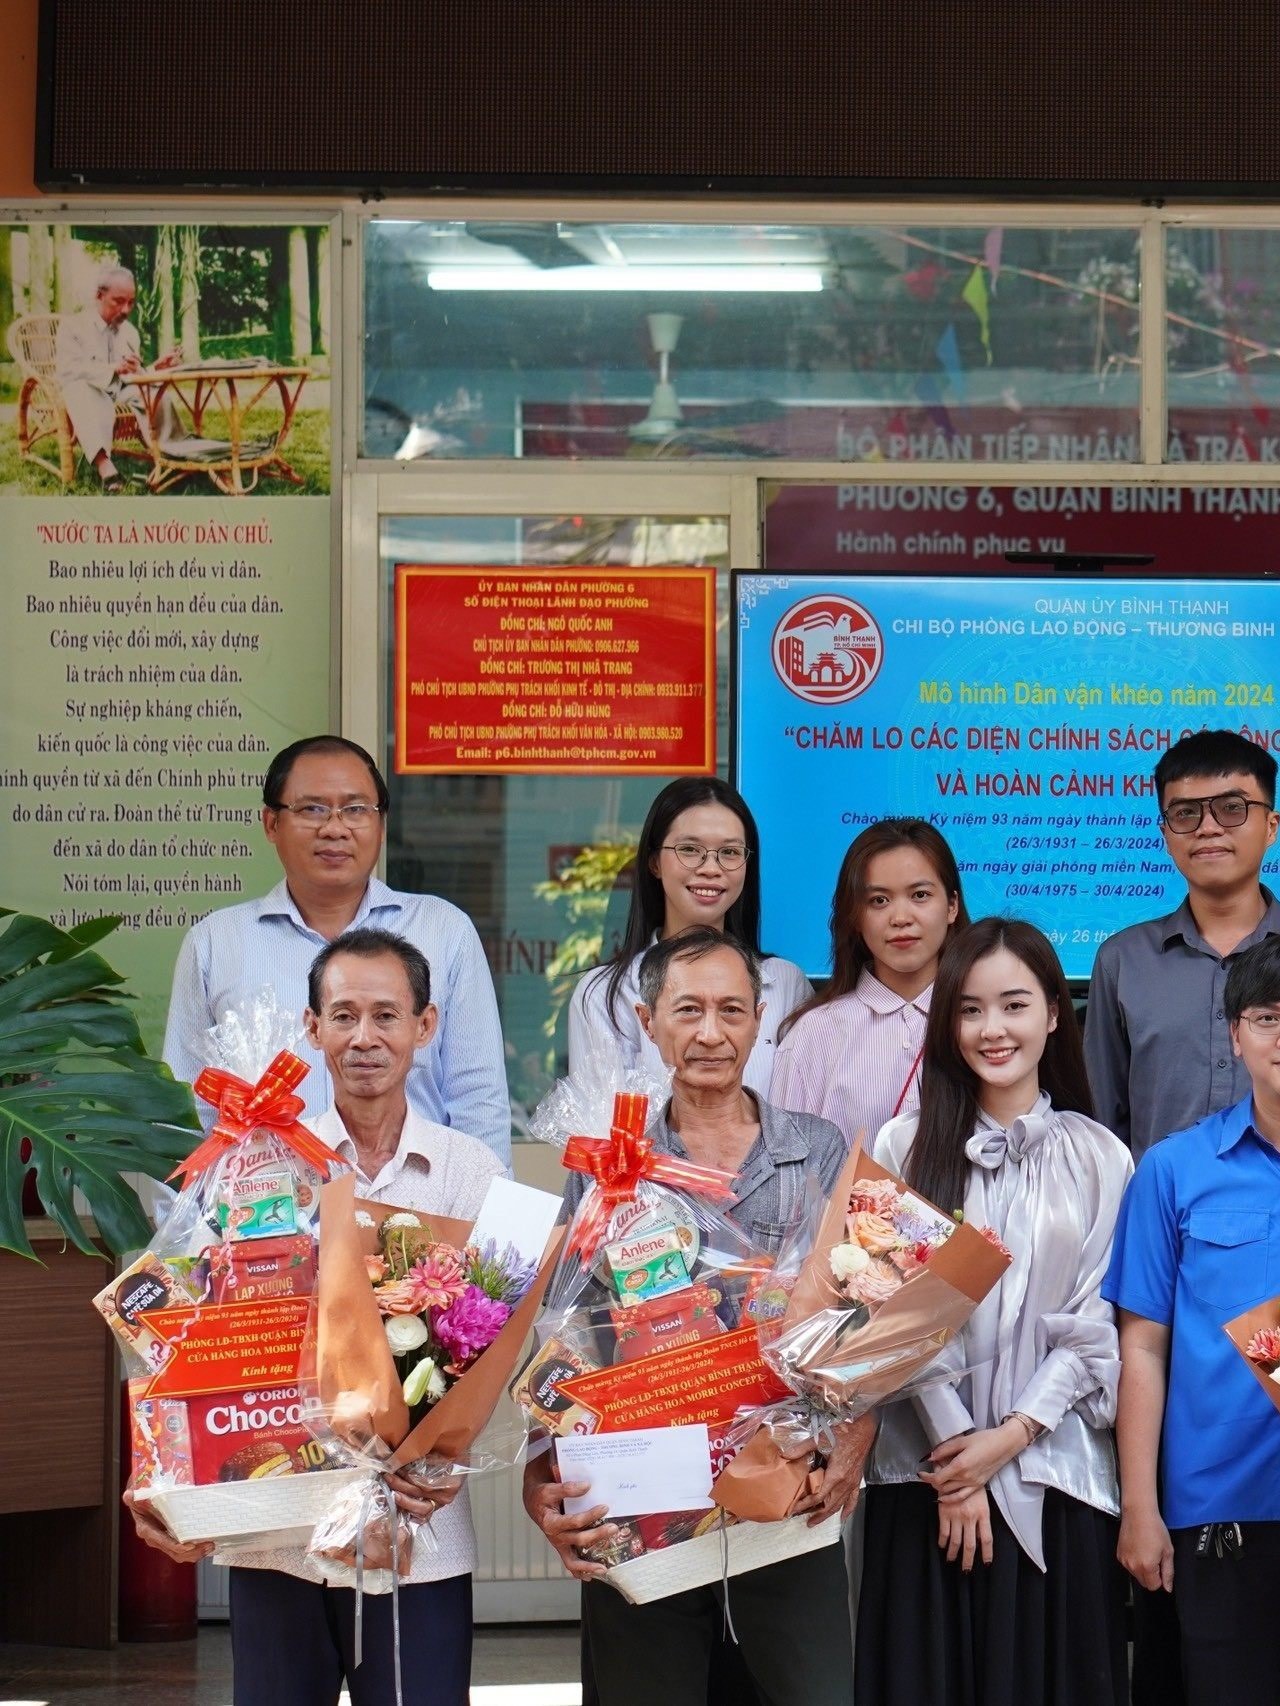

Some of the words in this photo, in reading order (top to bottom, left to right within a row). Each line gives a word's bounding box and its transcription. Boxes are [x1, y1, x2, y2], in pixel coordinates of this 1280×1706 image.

[94, 525, 113, 543] TA
[119, 520, 139, 543] LÀ
[144, 520, 189, 543] NƯỚC
[195, 519, 228, 544] DÂN
[234, 518, 272, 544] CHỦ.
[837, 531, 896, 553] Hành
[904, 530, 966, 554] chính
[49, 560, 77, 578] Bao
[82, 560, 124, 578] nhiêu
[129, 560, 147, 583] lợi
[153, 560, 174, 578] ích
[179, 557, 206, 578] đều
[211, 561, 224, 578] vì
[229, 560, 261, 578] dân.
[625, 582, 635, 593] 6
[1035, 599, 1086, 615] QUẬN
[1092, 597, 1116, 614] ỦY
[1121, 597, 1163, 614] BÌNH
[1168, 600, 1229, 616] THẠNH
[50, 629, 88, 652] Công
[93, 630, 123, 653] việc
[127, 626, 150, 648] đổi
[155, 630, 186, 650] mới,
[191, 630, 217, 652] xây
[221, 629, 259, 653] dựng
[892, 619, 923, 634] CHI
[928, 618, 955, 638] BỘ
[960, 617, 1025, 635] PHÒNG
[1031, 620, 1068, 635] LAO
[1073, 618, 1126, 639] ĐỘNG
[1149, 620, 1227, 638] THƯƠNG
[1233, 622, 1275, 637] BINH
[66, 664, 79, 683] là
[84, 664, 123, 683] trách
[129, 664, 175, 687] nhiệm
[180, 663, 205, 683] của
[210, 664, 242, 682] dân.
[920, 682, 952, 704] Mô
[959, 682, 1006, 704] hình
[1015, 682, 1057, 705] Dân
[1064, 682, 1103, 710] vận
[1110, 683, 1163, 706] khéo
[1170, 684, 1217, 706] năm
[1224, 683, 1275, 706] 2024
[66, 699, 86, 722] Sự
[90, 699, 141, 722] nghiệp
[146, 699, 192, 721] kháng
[197, 697, 242, 719] chiến,
[873, 727, 903, 749] LO
[911, 722, 958, 750] CÁC
[967, 725, 1020, 755] DIỆN
[1029, 723, 1100, 751] CHÍNH
[1107, 723, 1172, 752] SÁCH
[456, 746, 491, 758] Email:
[936, 768, 968, 796] VÀ
[976, 768, 1041, 796] HOÀN
[1050, 769, 1114, 797] CẢNH
[233, 1179, 279, 1195] Anlene
[620, 1237, 667, 1260] Anlene
[247, 1262, 279, 1274] VISSAN
[651, 1317, 683, 1335] VISSAN
[181, 1337, 215, 1350] PHÒNG
[241, 1346, 262, 1357] HOA
[264, 1343, 297, 1356] MORRI
[241, 1365, 268, 1377] Kính
[270, 1363, 294, 1375] tặng
[686, 1388, 719, 1404] MORRI
[720, 1373, 762, 1393] CONCEPT
